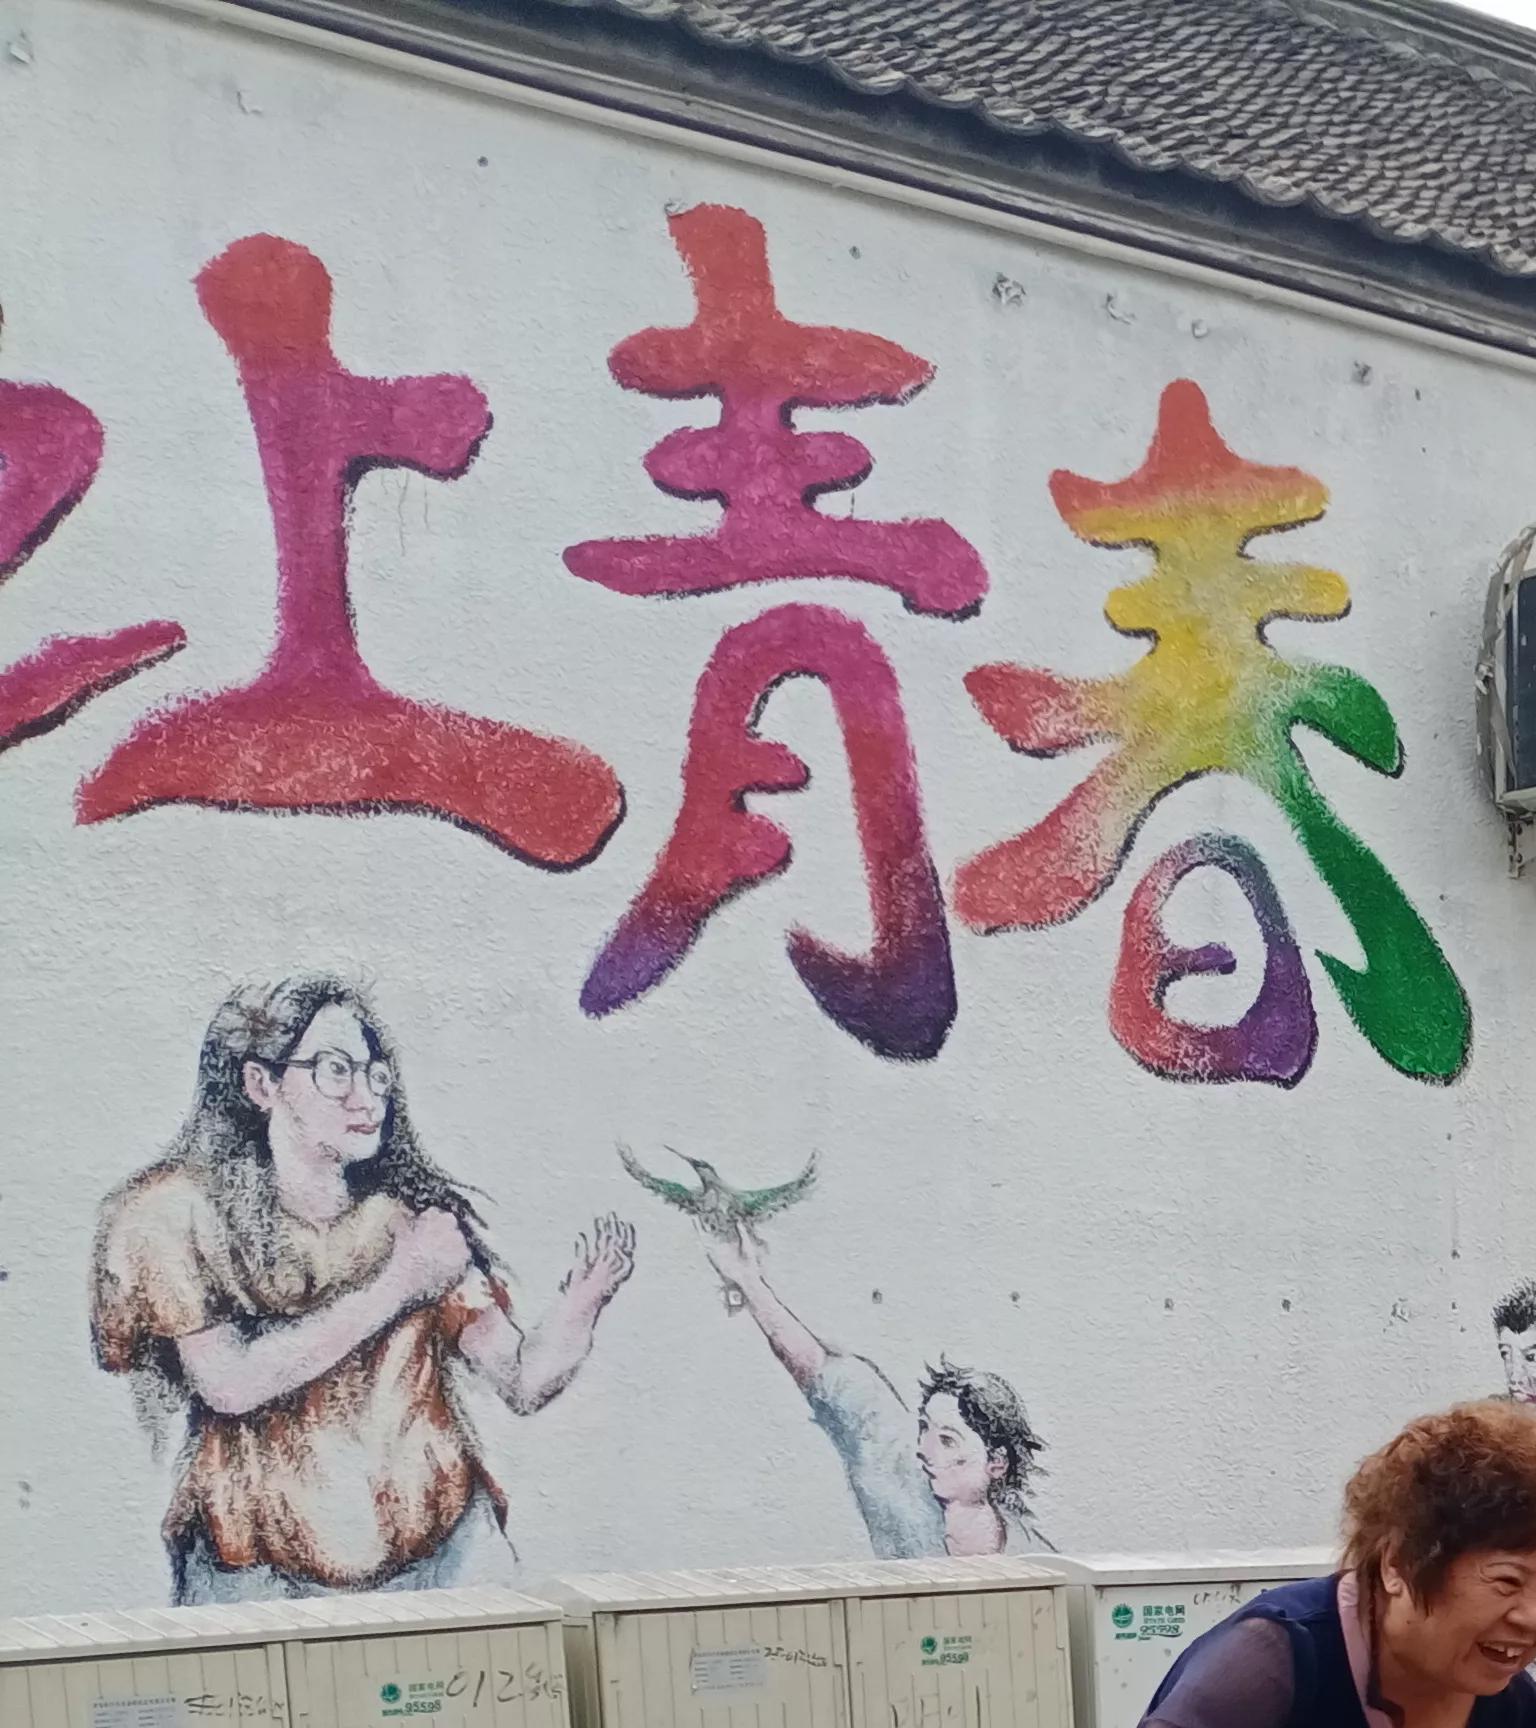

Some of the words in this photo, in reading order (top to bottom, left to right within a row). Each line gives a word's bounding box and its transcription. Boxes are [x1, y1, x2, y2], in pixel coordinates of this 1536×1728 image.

[1142, 1604, 1186, 1617] 国家电网
[405, 1699, 442, 1714] 95598
